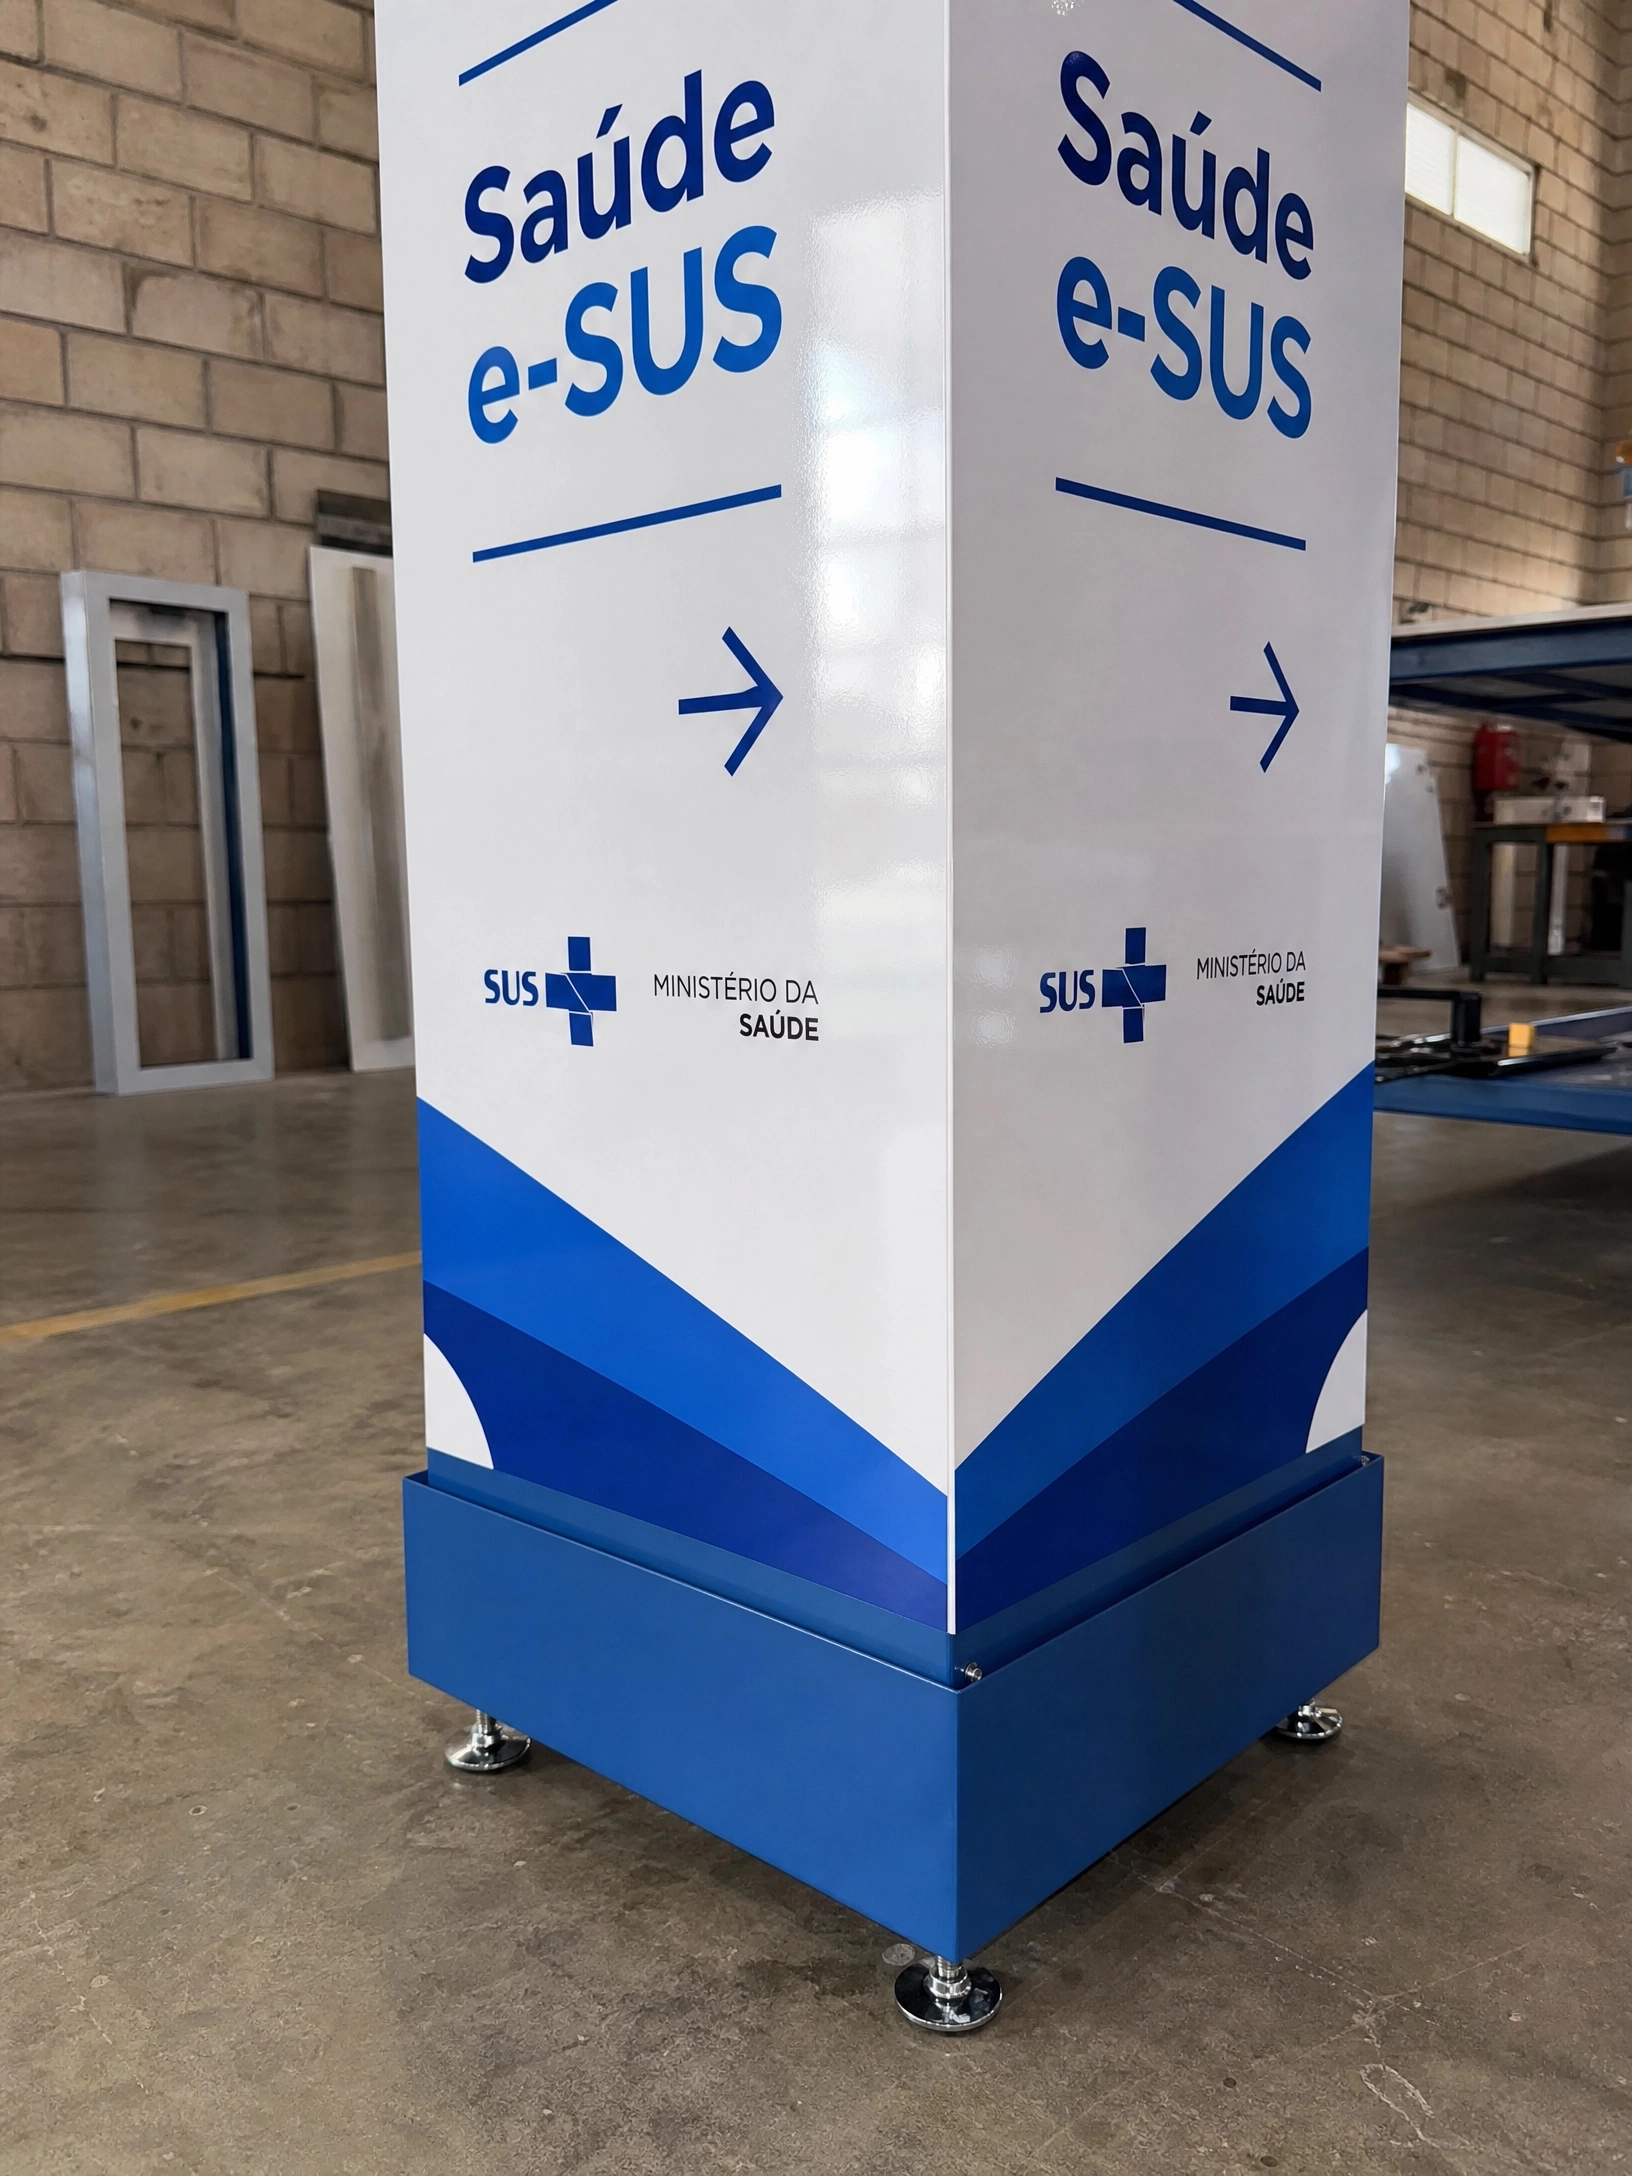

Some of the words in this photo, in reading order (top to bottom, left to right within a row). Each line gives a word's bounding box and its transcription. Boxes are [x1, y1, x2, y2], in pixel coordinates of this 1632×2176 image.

[464, 69, 775, 284] Saúde
[1057, 51, 1314, 280] Saúde
[467, 225, 782, 444] e-SUS
[1056, 256, 1312, 439] e-SUS
[1196, 948, 1282, 980] MINISTÉRIO
[1286, 951, 1306, 972] DA
[484, 969, 539, 1007] SUS
[653, 971, 777, 1002] MINISTÉRIO
[785, 979, 819, 1005] DA
[1039, 969, 1096, 1014] SUS
[1256, 977, 1305, 1006] SAÚDE
[739, 1009, 819, 1041] SAÚDE
